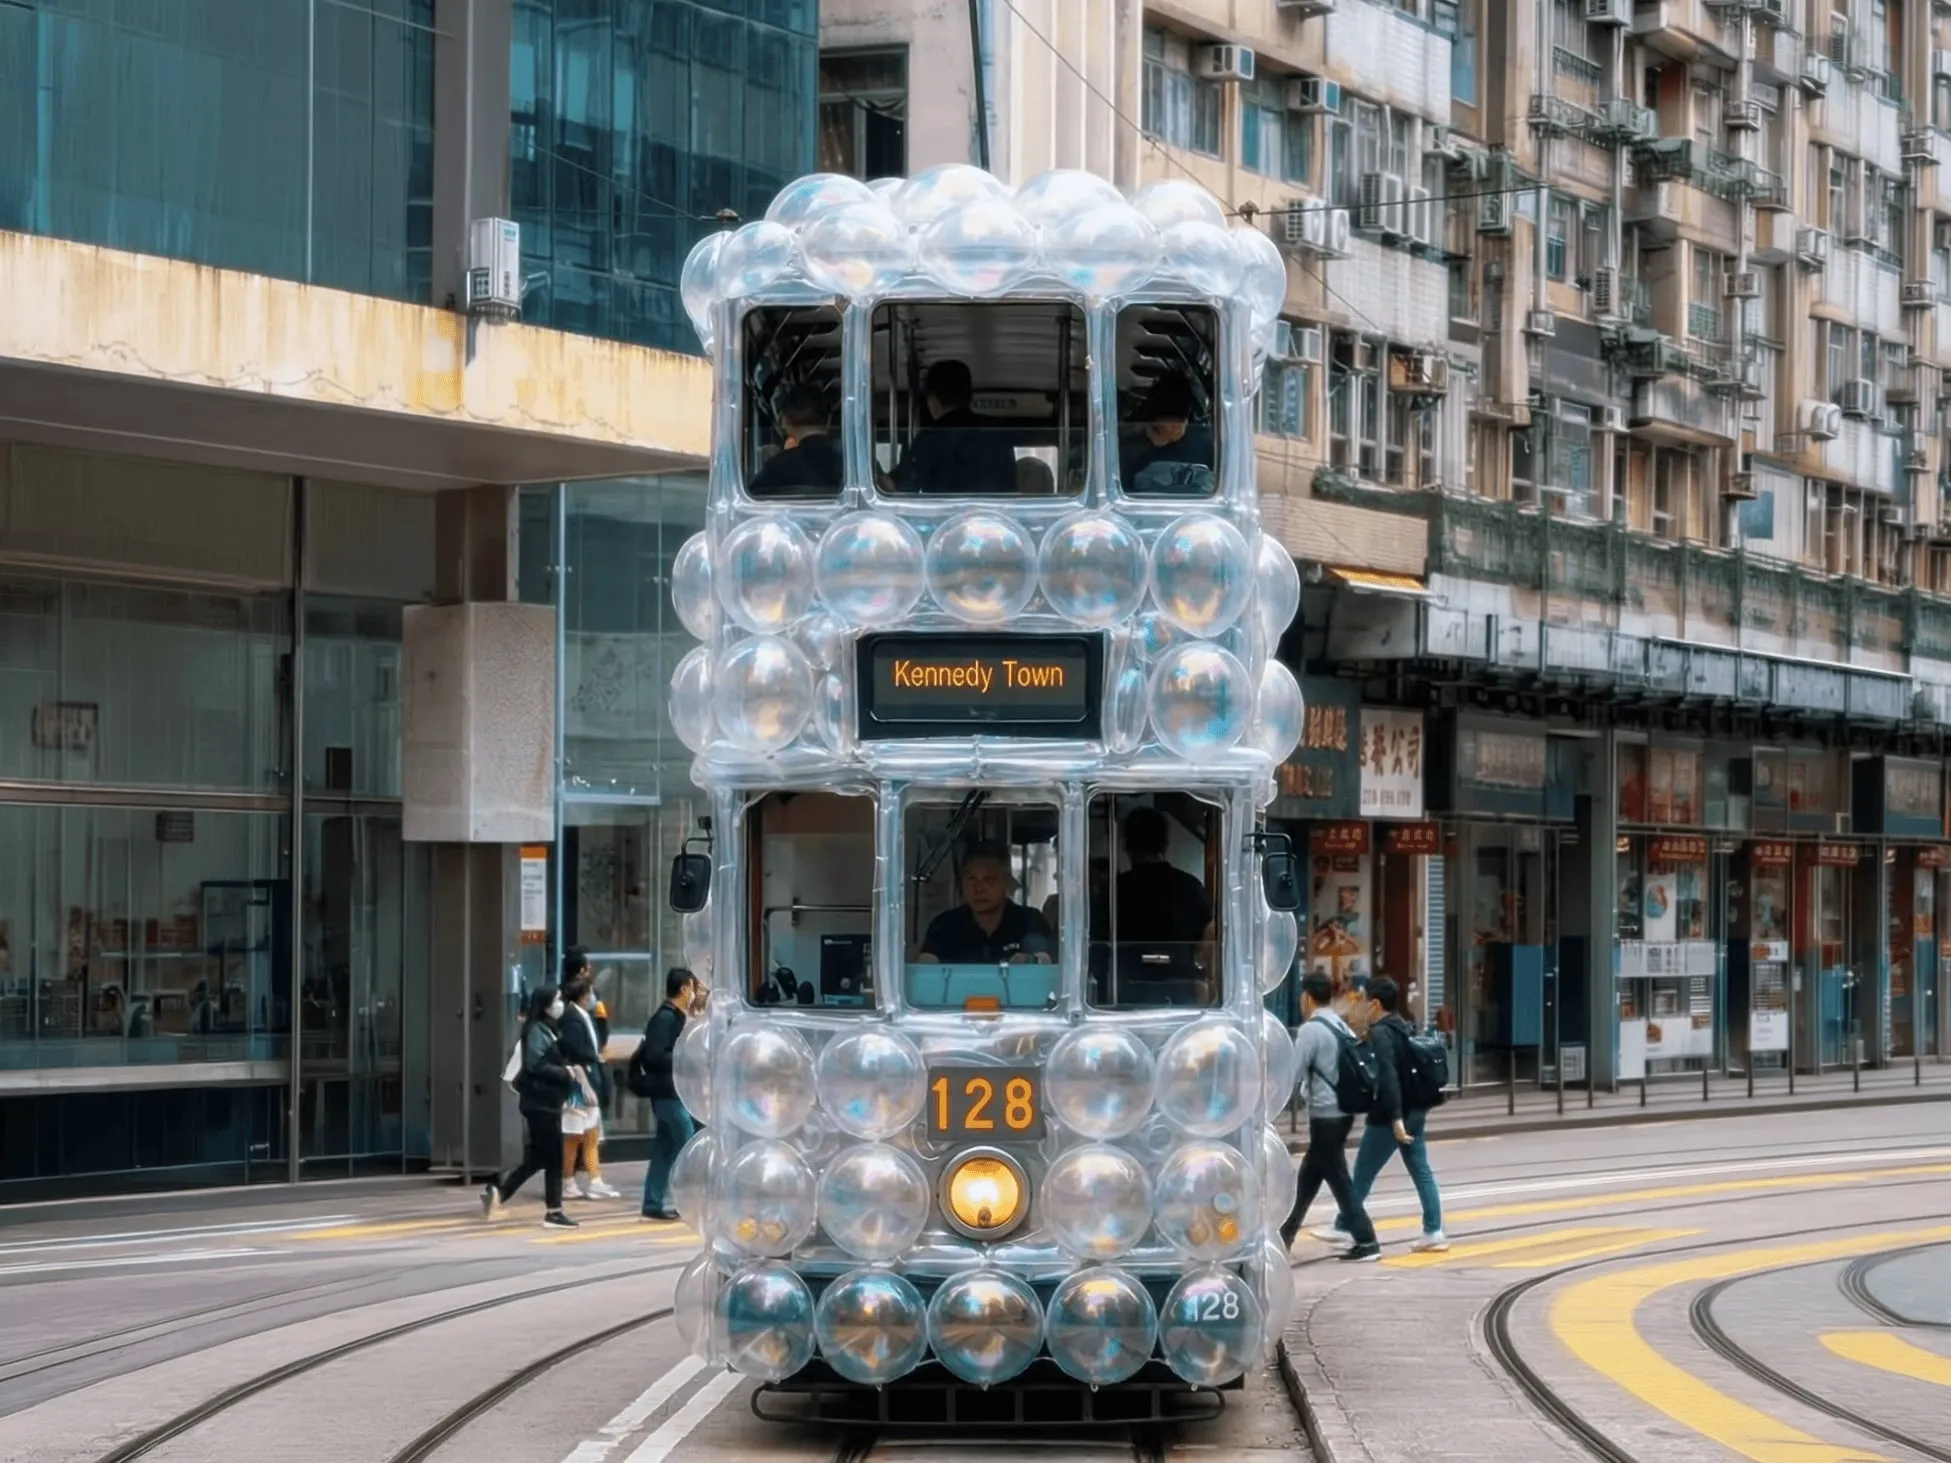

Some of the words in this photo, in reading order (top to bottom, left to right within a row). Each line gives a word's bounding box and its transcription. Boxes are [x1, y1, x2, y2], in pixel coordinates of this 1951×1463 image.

[894, 659, 993, 694] Kennedy
[1002, 660, 1064, 688] Town
[931, 1076, 1034, 1131] 128
[1187, 1291, 1239, 1322] 128
